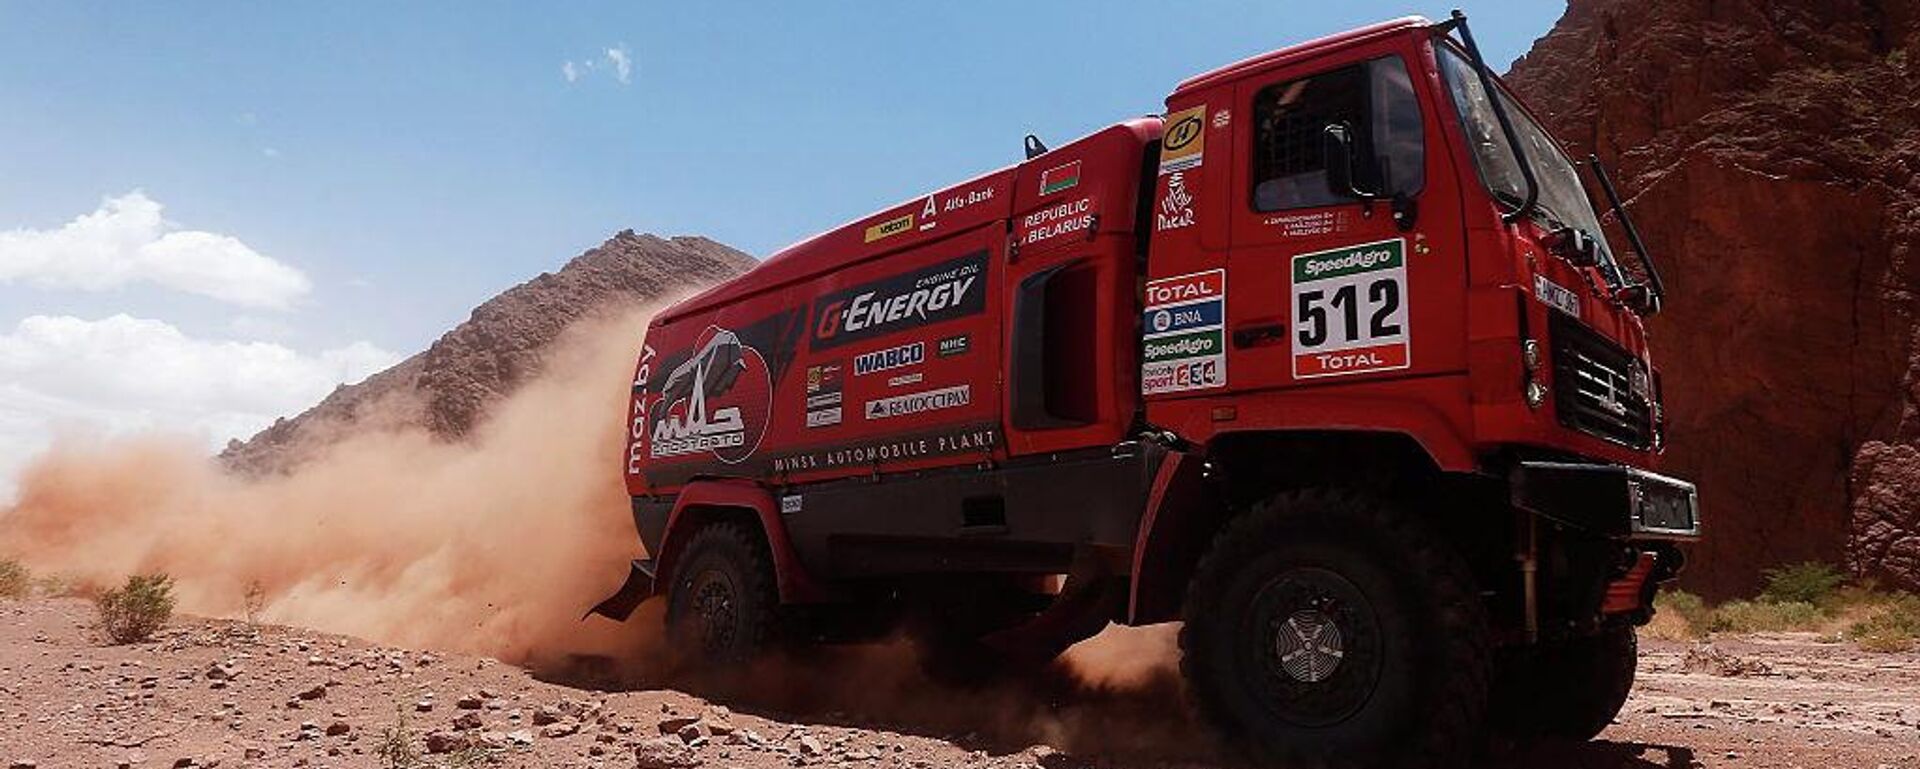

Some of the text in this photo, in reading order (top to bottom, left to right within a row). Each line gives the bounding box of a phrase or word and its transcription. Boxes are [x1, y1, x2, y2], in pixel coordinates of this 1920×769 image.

[1024, 198, 1089, 228] REPUBLIC
[1028, 215, 1092, 243] BELARUS
[915, 263, 979, 289] ENGINE OIL
[1304, 249, 1391, 276] SpeedAgro
[1174, 309, 1203, 326] BNA
[1298, 278, 1402, 347] 512
[855, 342, 924, 374] WABCO
[1144, 338, 1213, 359] SpeedAgro
[628, 344, 656, 475] maz.by
[774, 430, 994, 471] MINSK AUTOMOBILE PLANT
